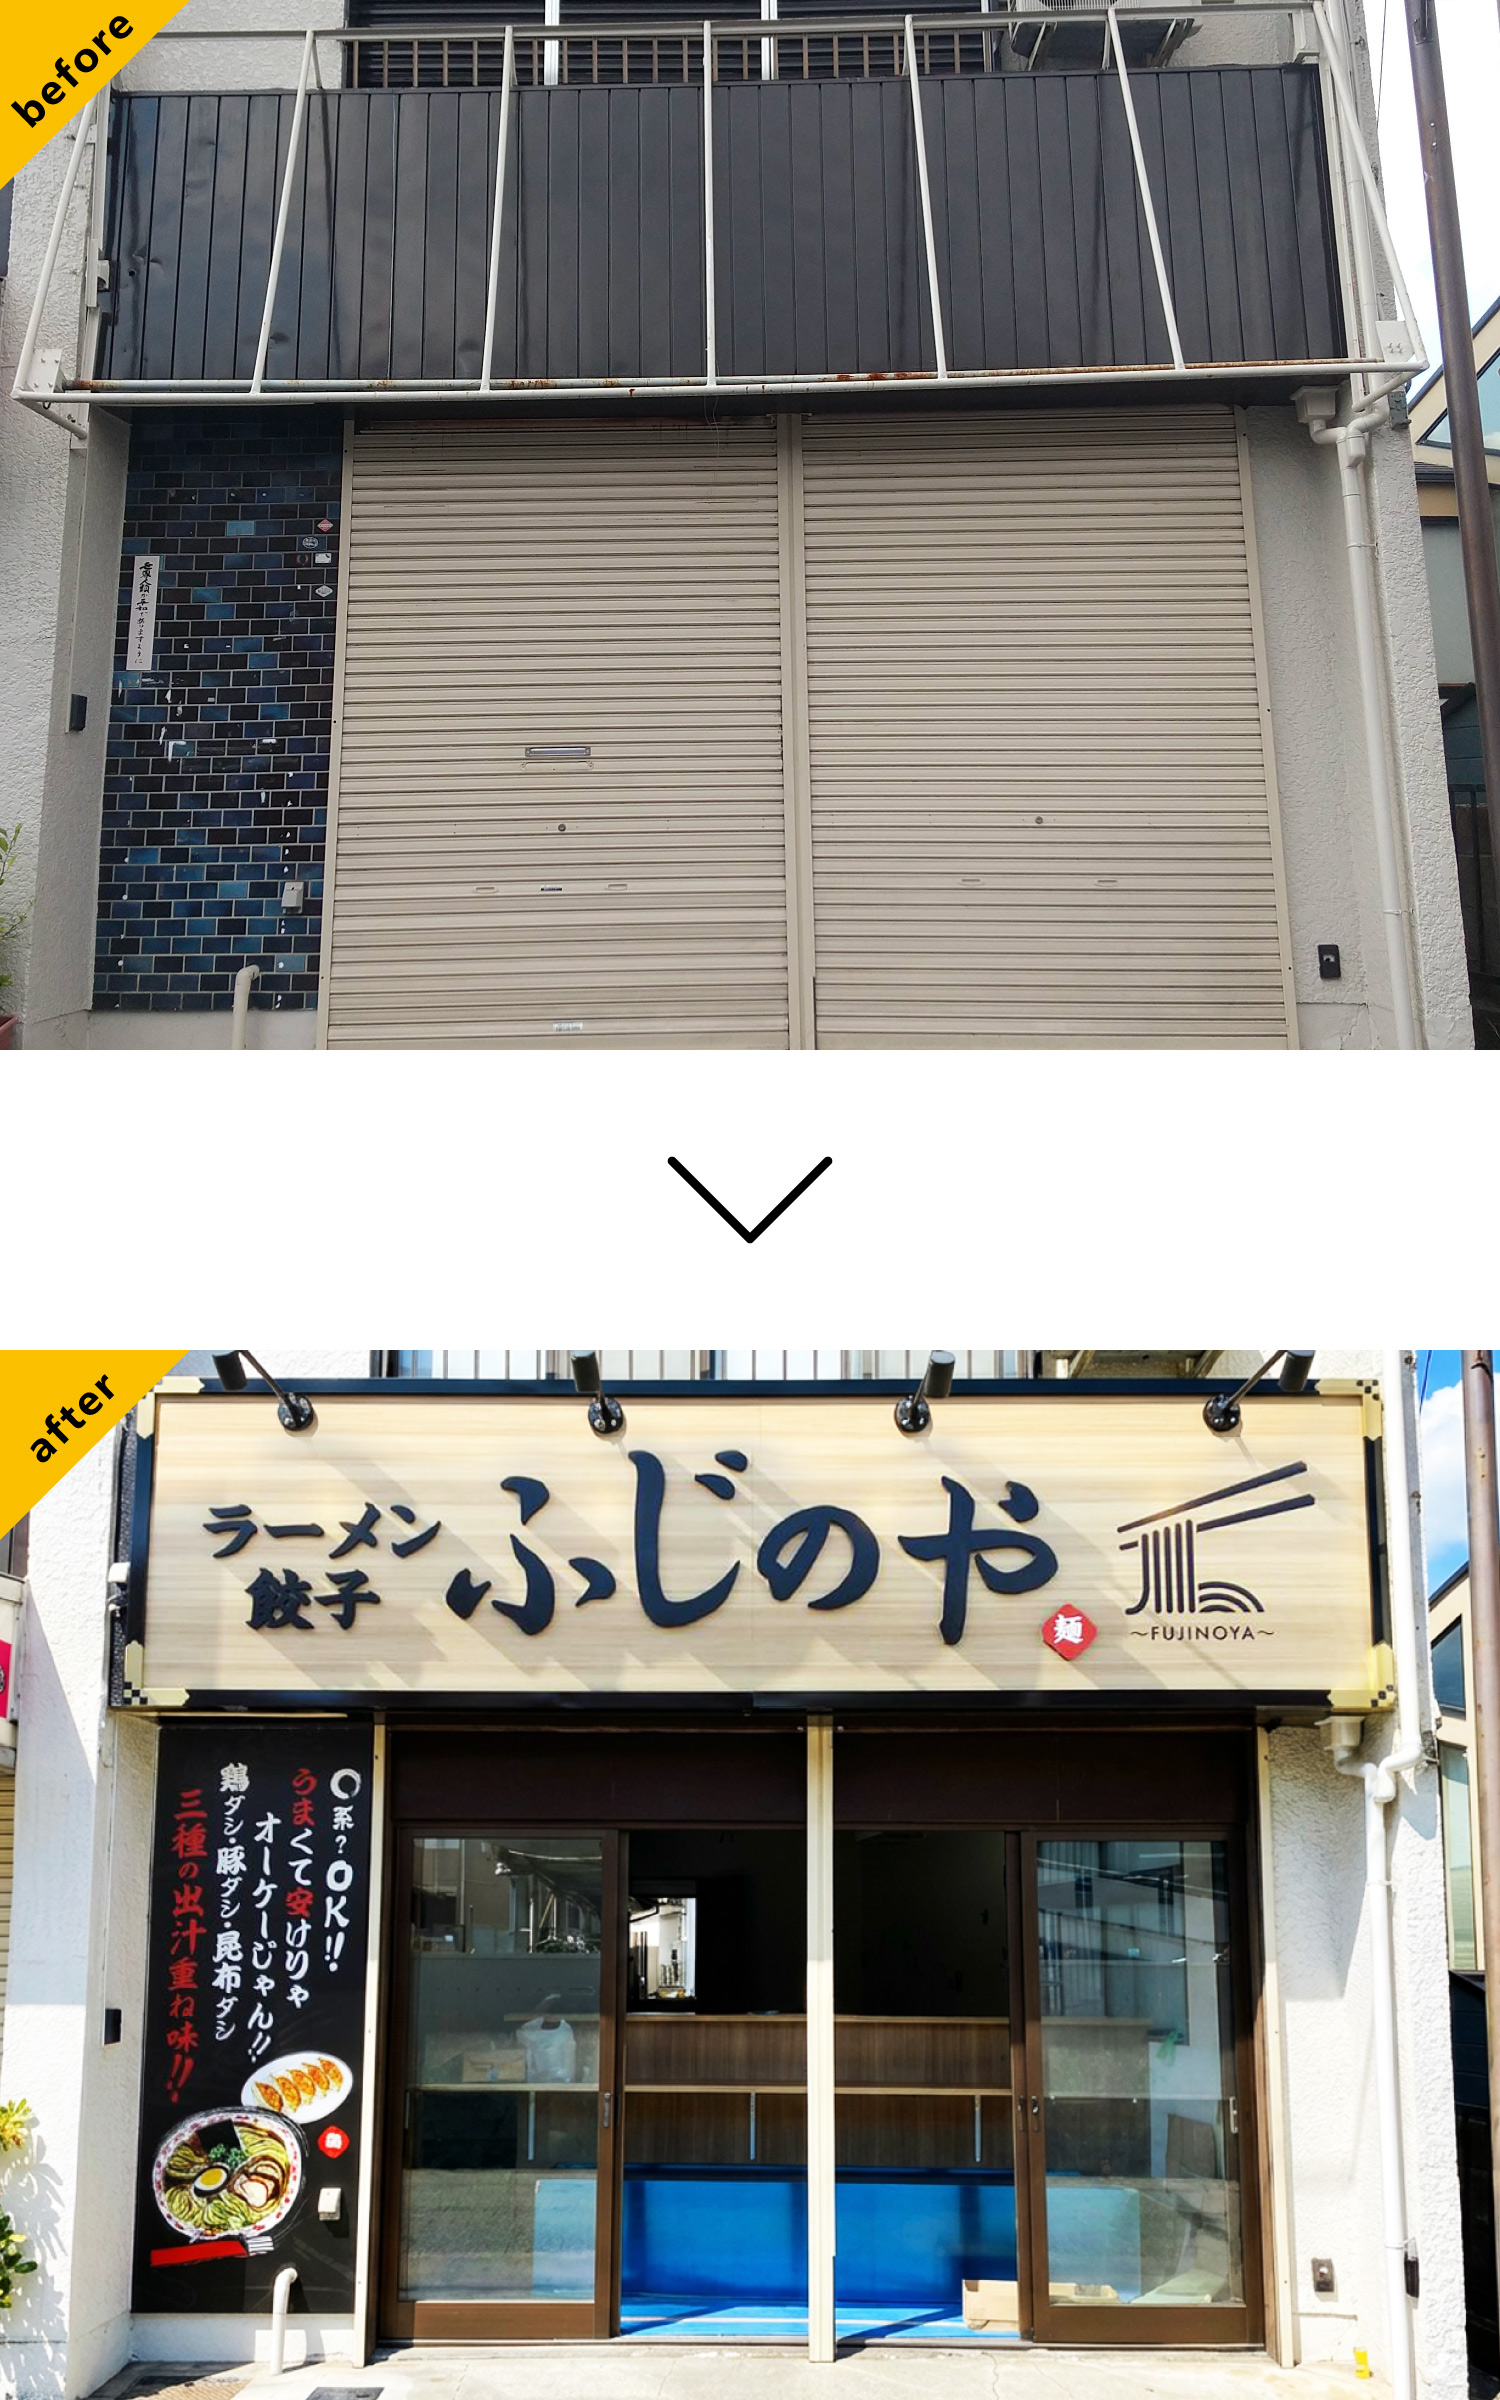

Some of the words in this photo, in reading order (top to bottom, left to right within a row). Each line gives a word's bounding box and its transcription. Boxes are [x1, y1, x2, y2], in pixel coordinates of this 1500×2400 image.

[203, 1502, 442, 1559] ラーメン
[446, 1450, 1059, 1646] ふじのや
[245, 1568, 381, 1630] 餃子
[1053, 1614, 1084, 1644] 麺
[285, 1768, 318, 2009] うまくて安けりゃ
